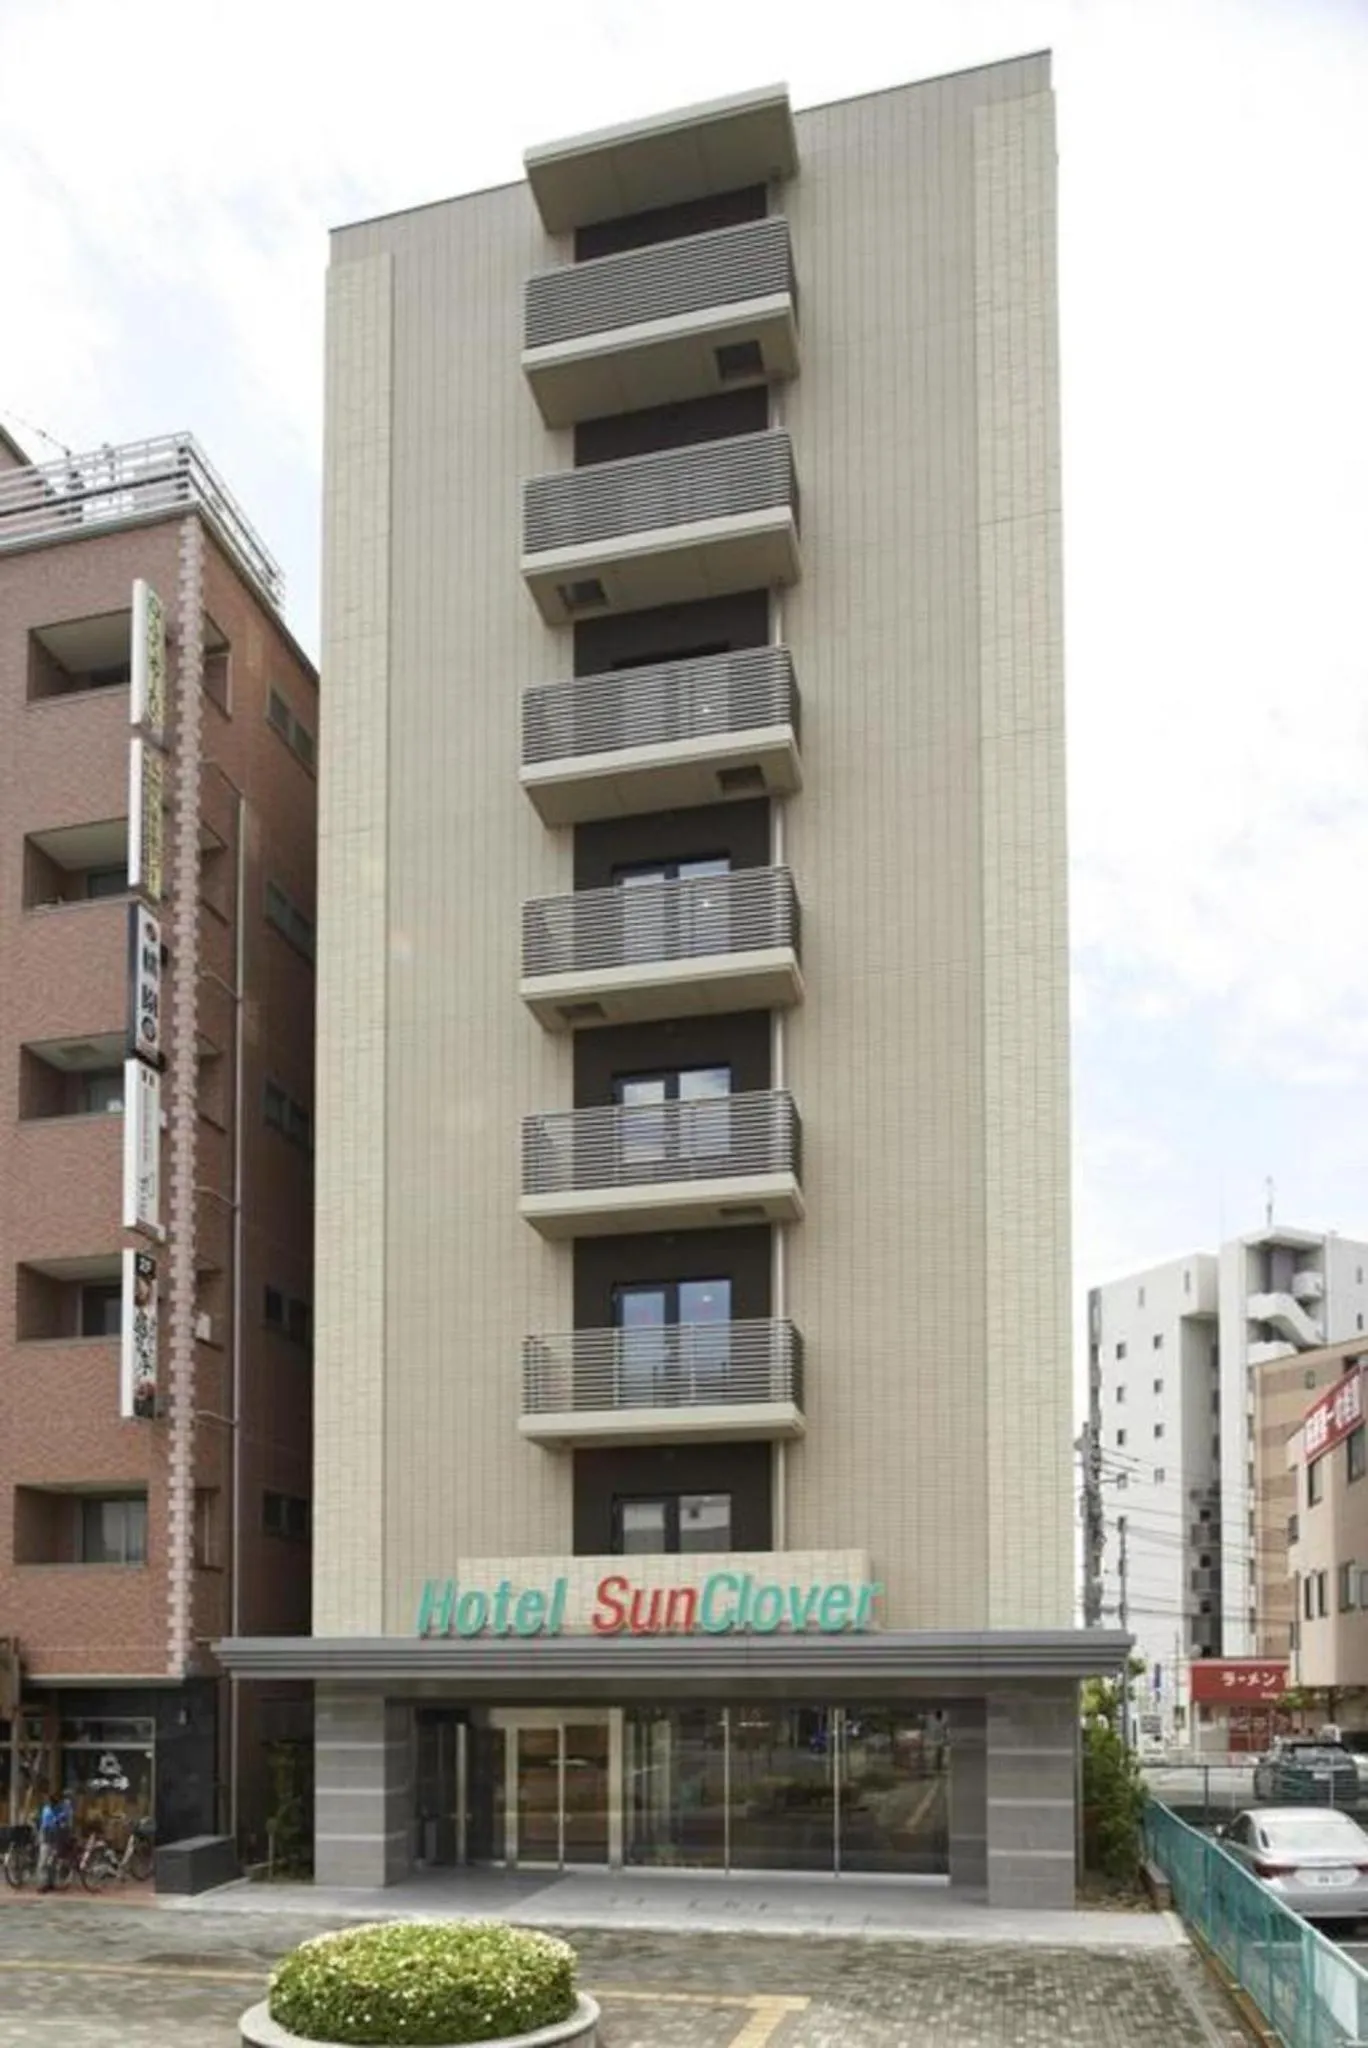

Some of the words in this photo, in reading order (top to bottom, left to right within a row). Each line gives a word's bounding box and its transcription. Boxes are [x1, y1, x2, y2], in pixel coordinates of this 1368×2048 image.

[418, 1578, 568, 1638] Hotel
[592, 1572, 883, 1635] SunClover
[1222, 1671, 1276, 1687] ラーメン
